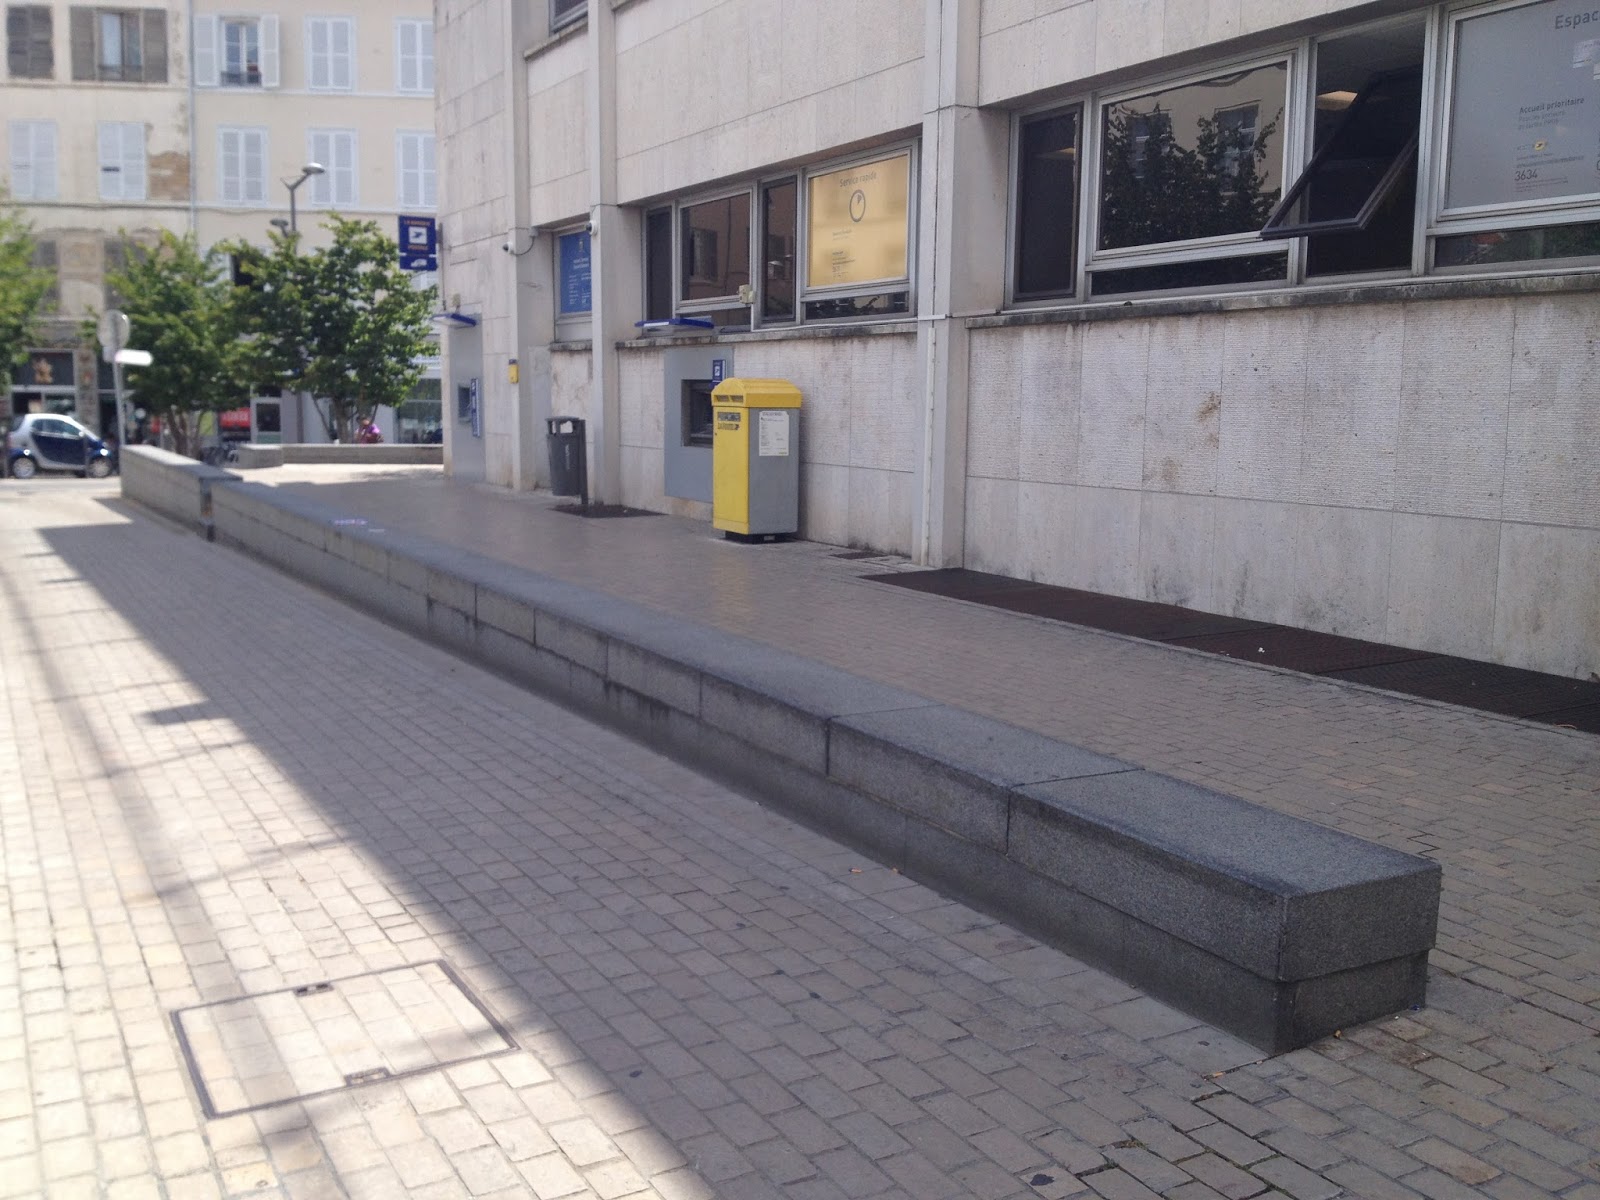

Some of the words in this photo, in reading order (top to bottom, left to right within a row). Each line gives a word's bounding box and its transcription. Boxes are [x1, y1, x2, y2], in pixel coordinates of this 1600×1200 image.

[1519, 103, 1545, 114] Accueil
[1546, 97, 1585, 111] prioritaire
[839, 177, 858, 188] Service
[859, 171, 877, 184] rapide
[1514, 168, 1538, 181] 3634
